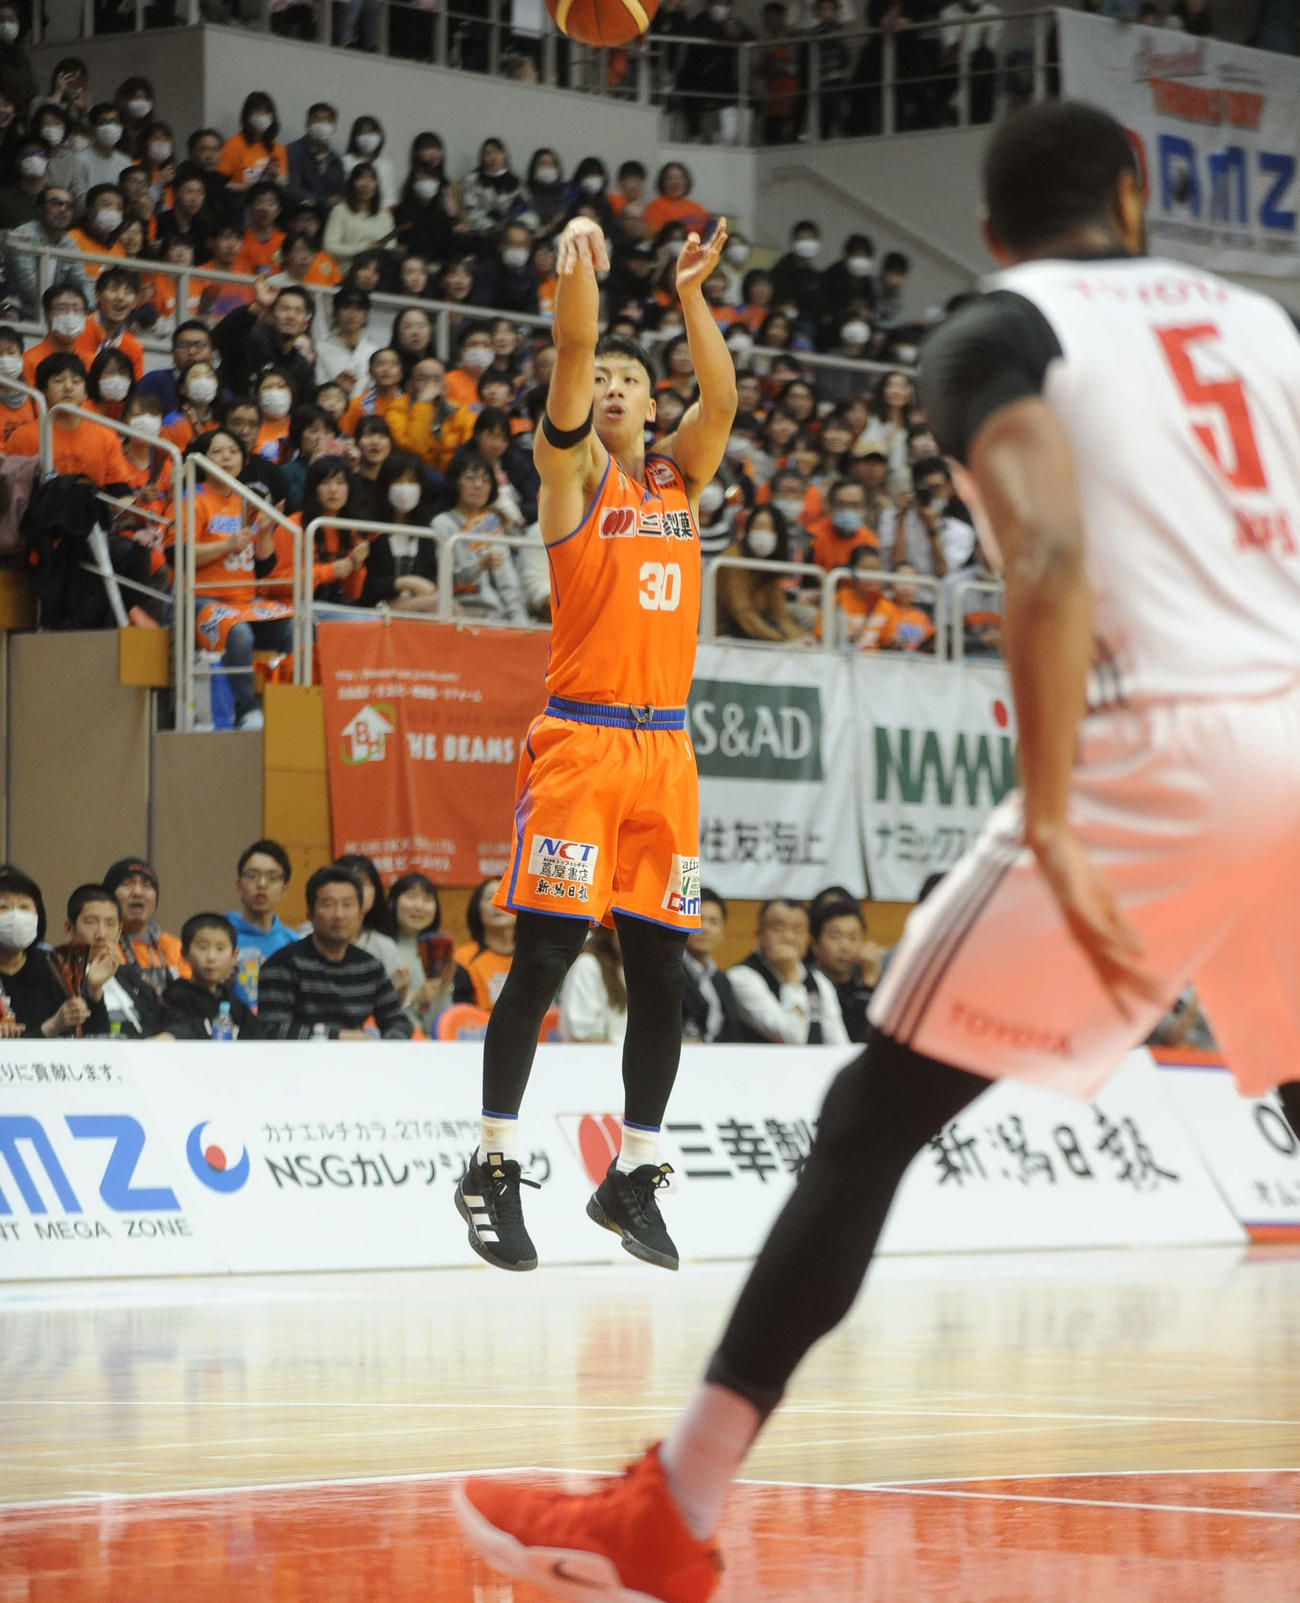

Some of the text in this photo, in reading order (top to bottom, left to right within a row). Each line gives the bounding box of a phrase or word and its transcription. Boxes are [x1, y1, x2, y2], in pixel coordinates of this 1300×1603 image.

[1152, 320, 1268, 491] 5
[639, 562, 681, 612] 30
[443, 733, 515, 765] BEAMS
[692, 701, 812, 760] S&AD
[874, 726, 1017, 807] NAMI
[539, 839, 594, 861] NCT
[665, 1119, 818, 1183] 三幸製
[34, 1221, 111, 1240] MEGA
[122, 1218, 193, 1238] ZONE
